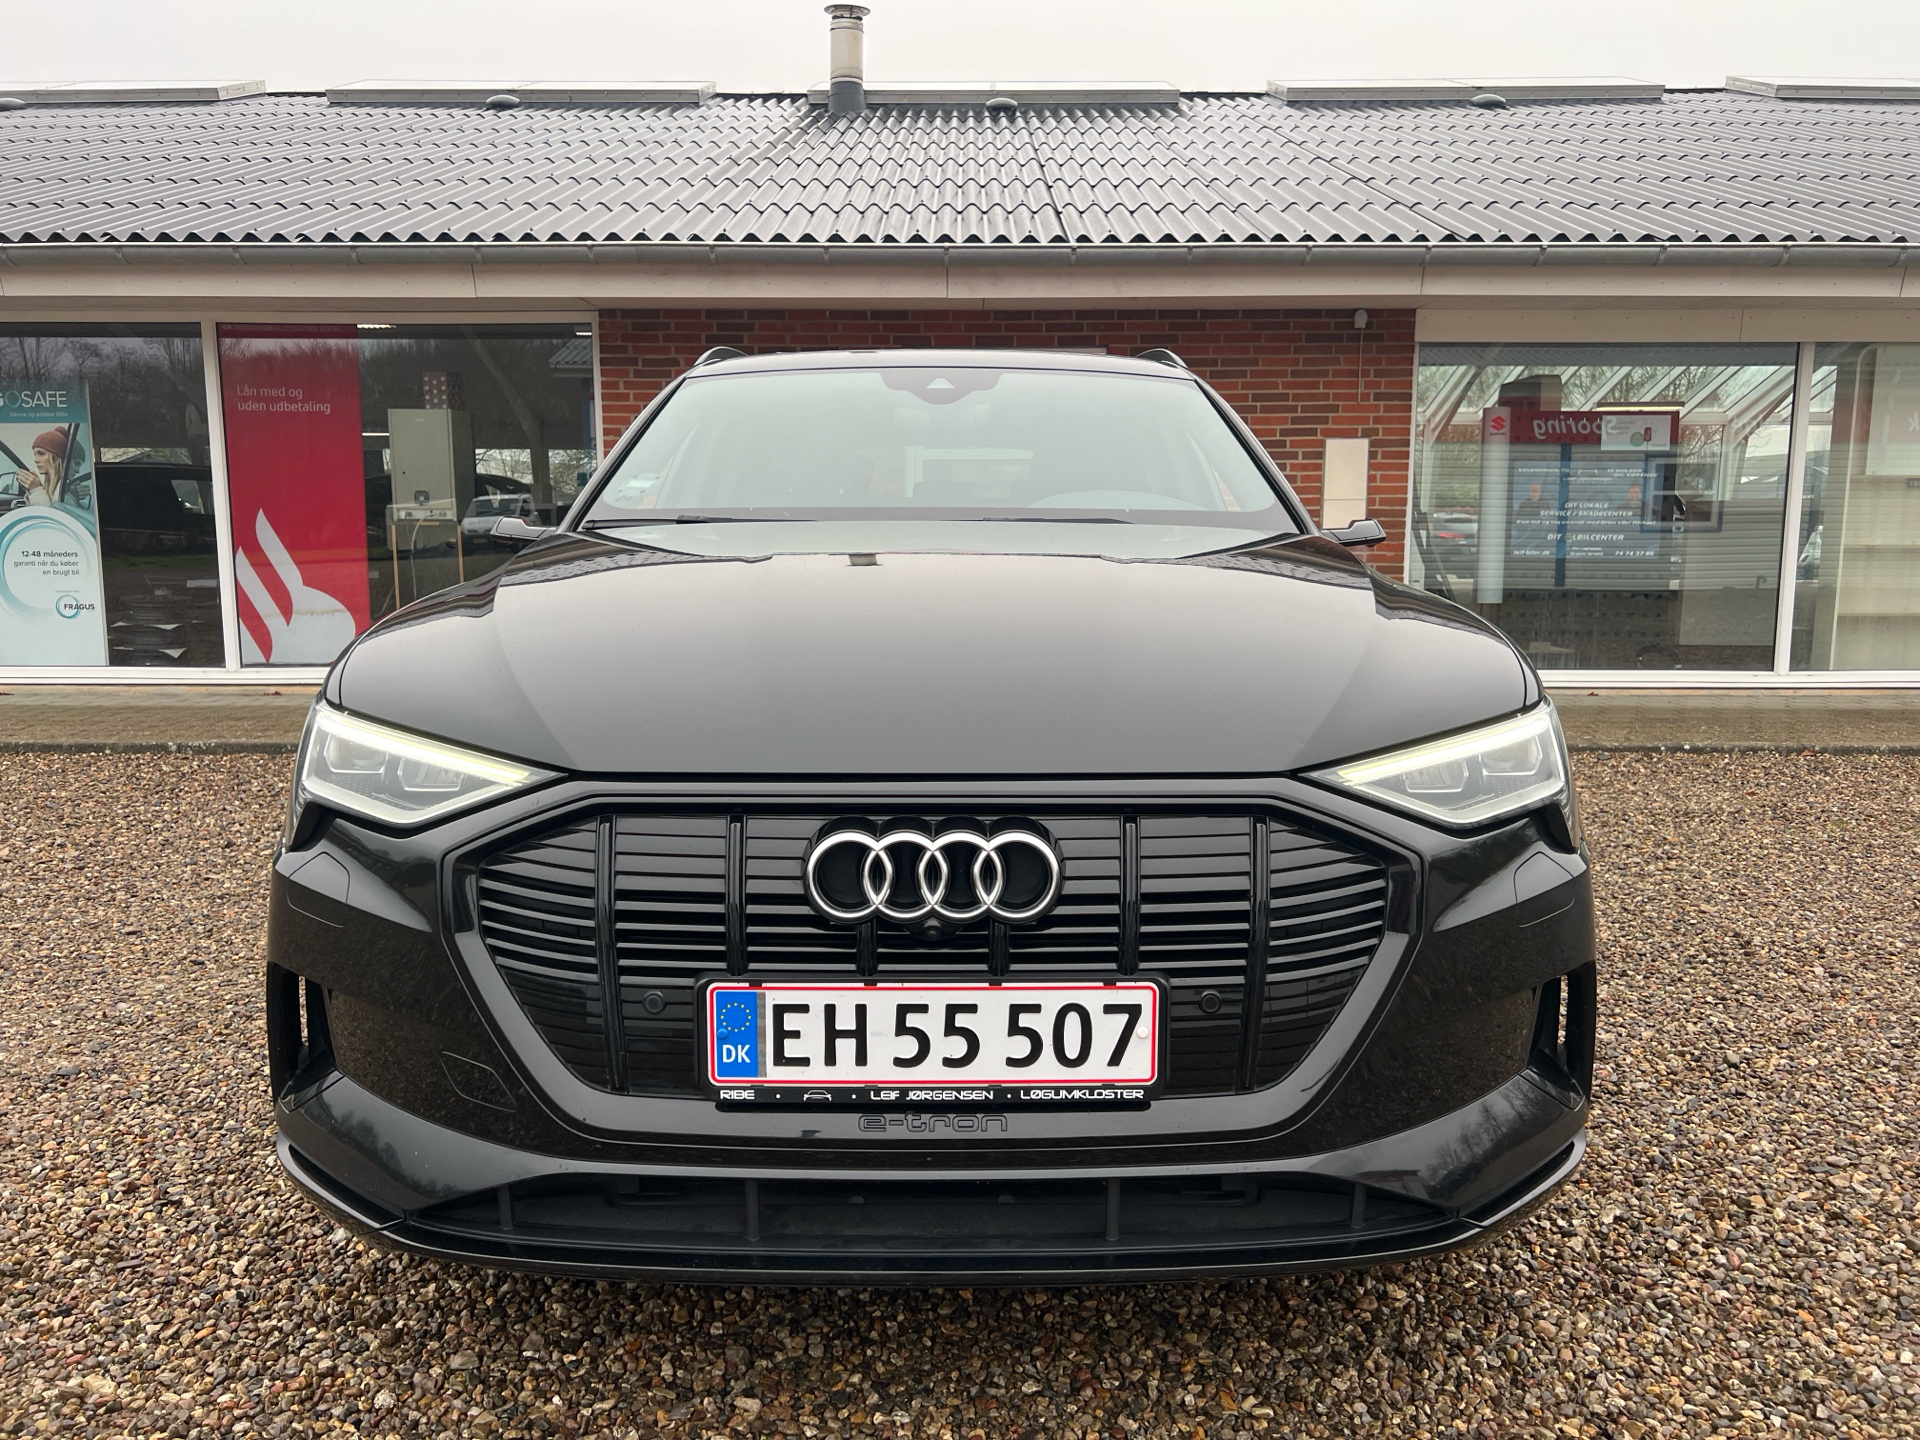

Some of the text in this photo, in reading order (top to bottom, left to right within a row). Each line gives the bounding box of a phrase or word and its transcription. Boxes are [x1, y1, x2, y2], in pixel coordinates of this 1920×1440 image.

[237, 384, 303, 400] Lån med og
[238, 401, 331, 414] uden udbetaling
[1547, 533, 1562, 541] DIT
[43, 550, 79, 558] måneders
[13, 560, 36, 568] garanti
[52, 569, 71, 577] brugt
[772, 1002, 1143, 1069] EH 55 507
[721, 1044, 751, 1064] DK
[720, 1089, 1144, 1100] RIBE LEIF JØRGENSEN LØGUMKLOSTER
[857, 1111, 1008, 1133] e-tron
